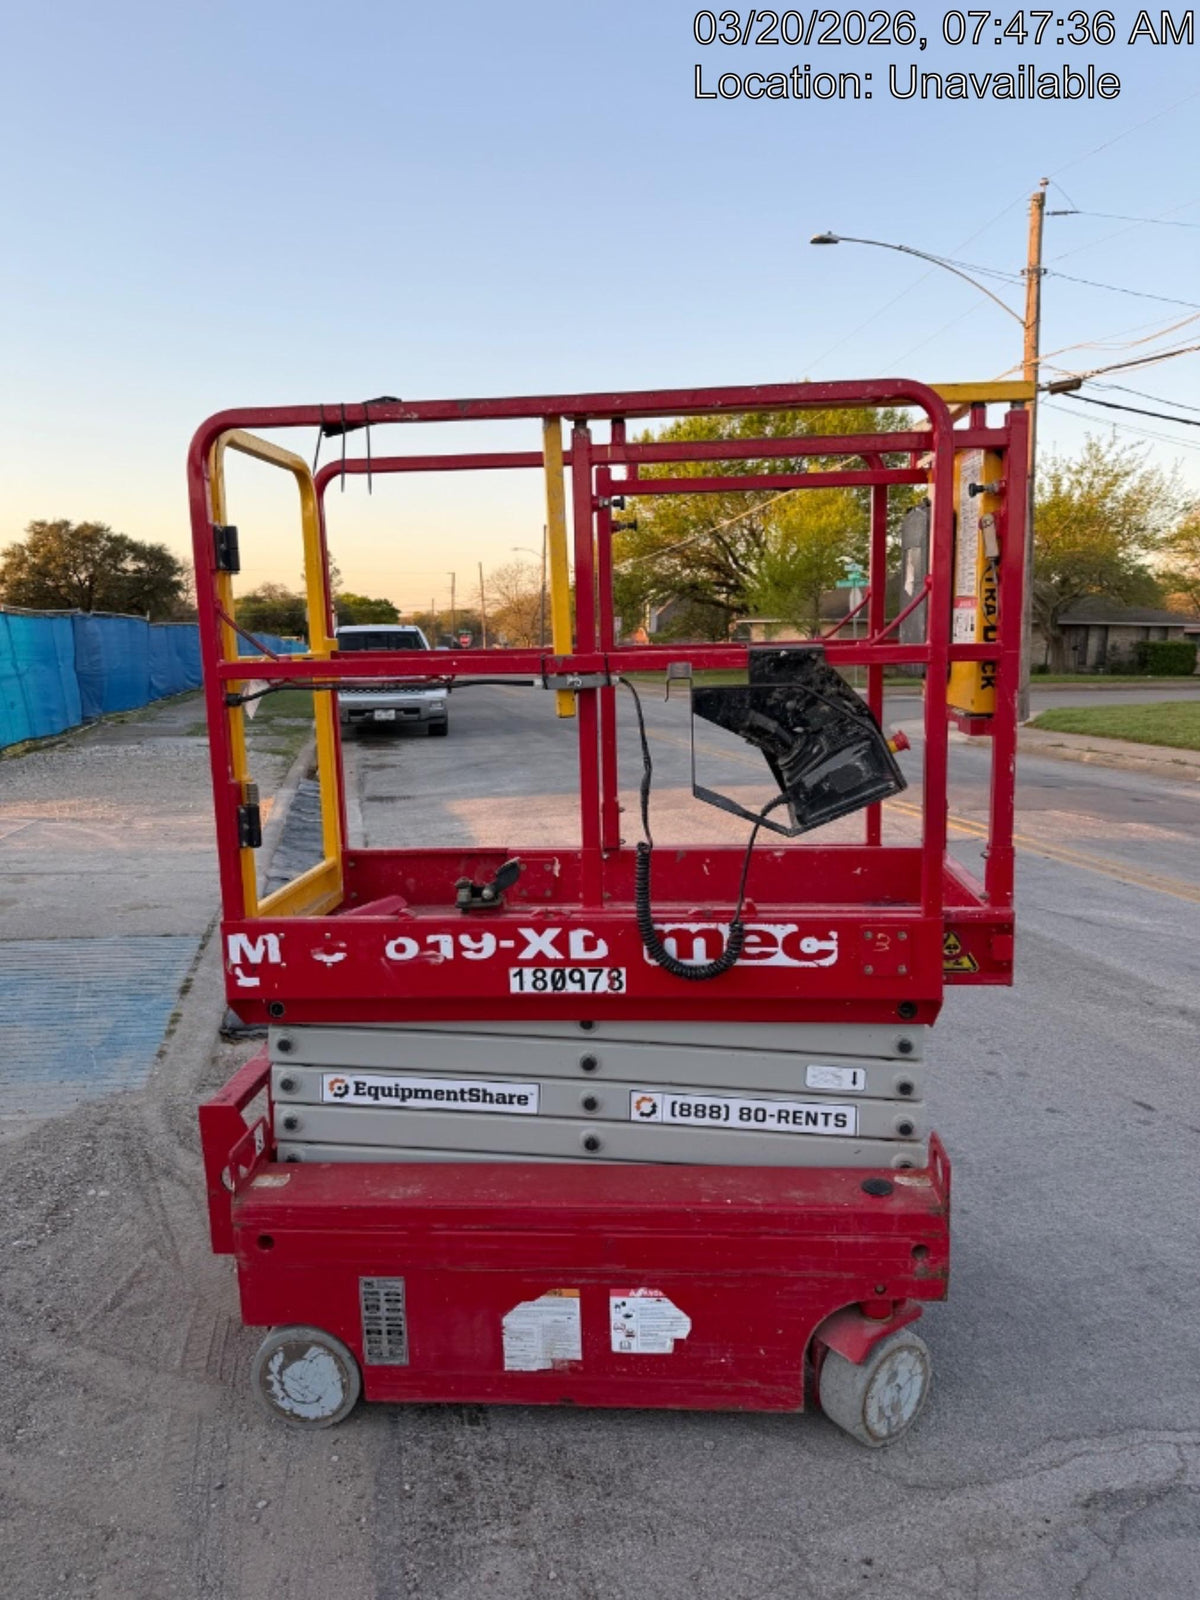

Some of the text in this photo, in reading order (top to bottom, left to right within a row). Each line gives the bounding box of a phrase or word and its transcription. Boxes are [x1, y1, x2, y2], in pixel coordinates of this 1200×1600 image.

[980, 625, 998, 690] DCK
[645, 924, 838, 966] mec
[511, 967, 624, 992] 180978
[353, 1080, 529, 1106] EquipmentShare
[670, 1100, 848, 1128] (888) 80-RENTS
